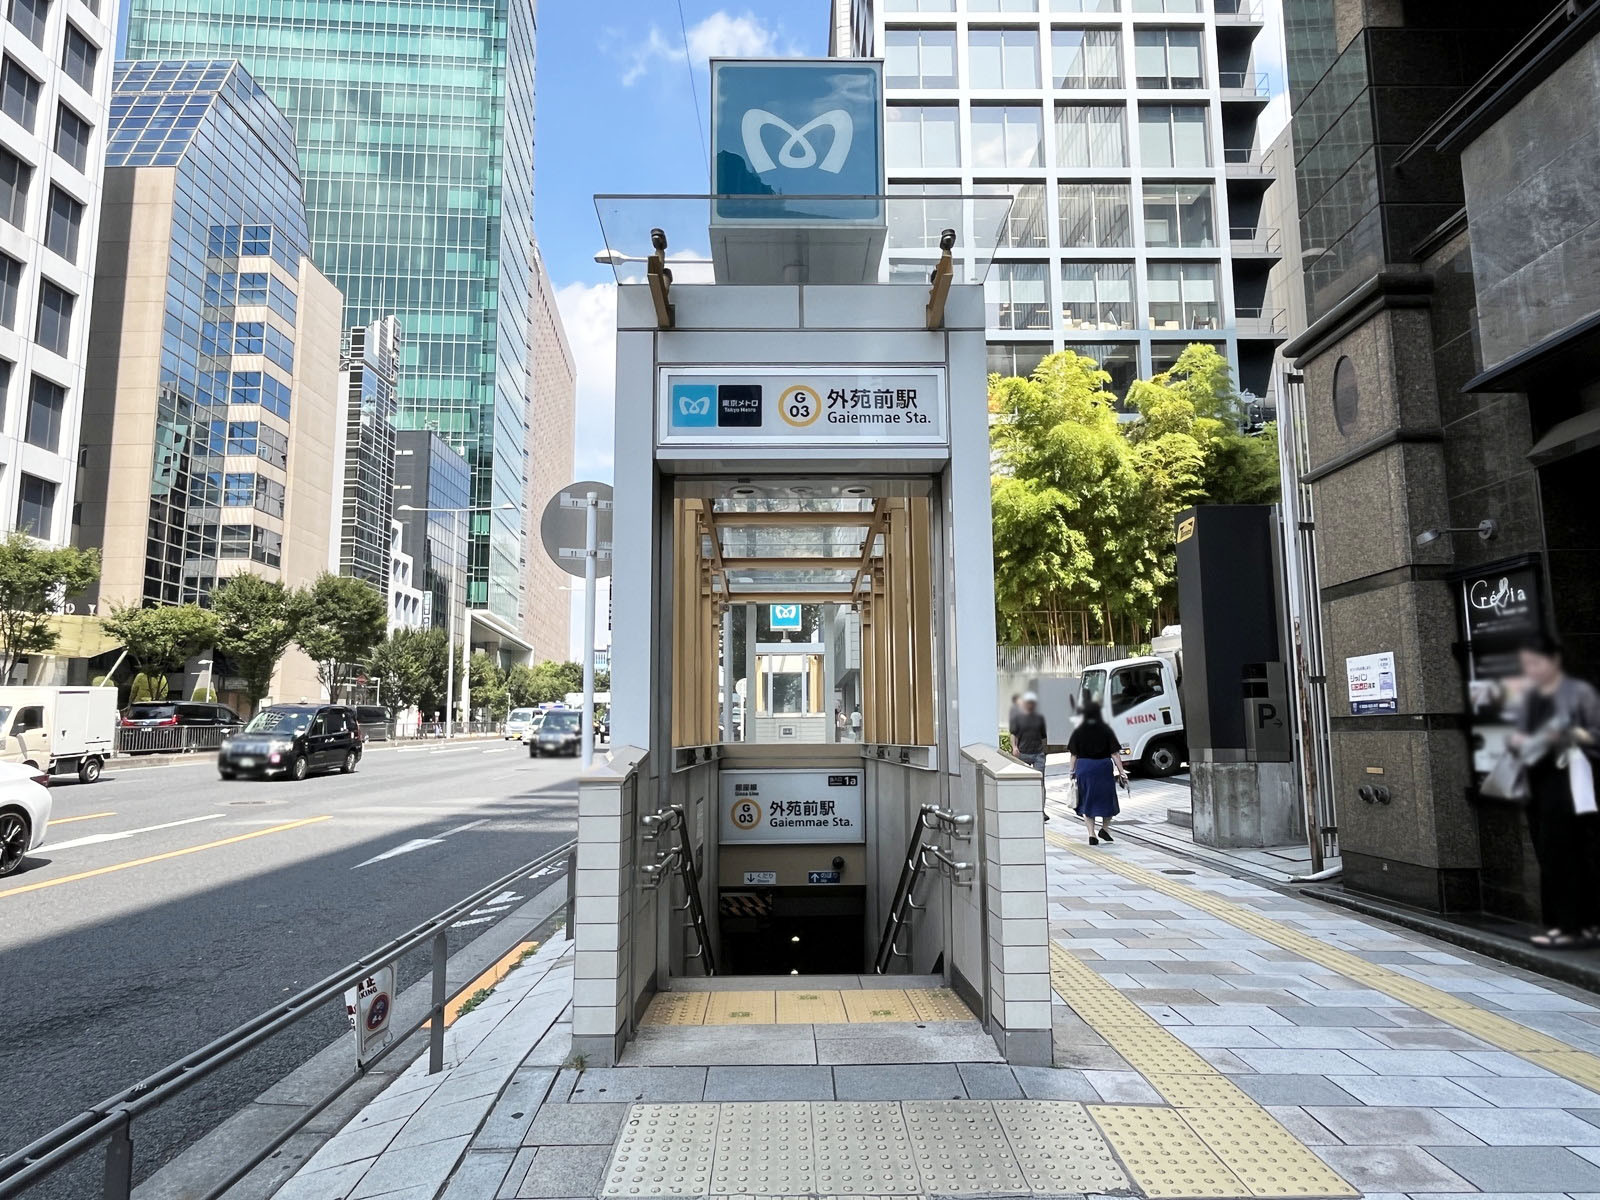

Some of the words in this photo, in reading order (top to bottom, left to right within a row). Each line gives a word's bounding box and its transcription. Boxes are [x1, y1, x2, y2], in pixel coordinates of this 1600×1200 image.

[794, 391, 806, 403] G
[827, 388, 918, 410] 外苑前駅
[789, 405, 810, 418] 03
[827, 411, 901, 424] Gaiemmae
[905, 411, 932, 424] Sta.
[1126, 713, 1157, 725] KIRIN
[1257, 703, 1277, 729] P
[844, 776, 857, 786] 1a
[742, 804, 751, 813] G
[769, 800, 835, 816] 外苑前駅
[739, 814, 754, 824] 03
[770, 817, 829, 828] Gaiemmae
[832, 817, 853, 827] Sta.
